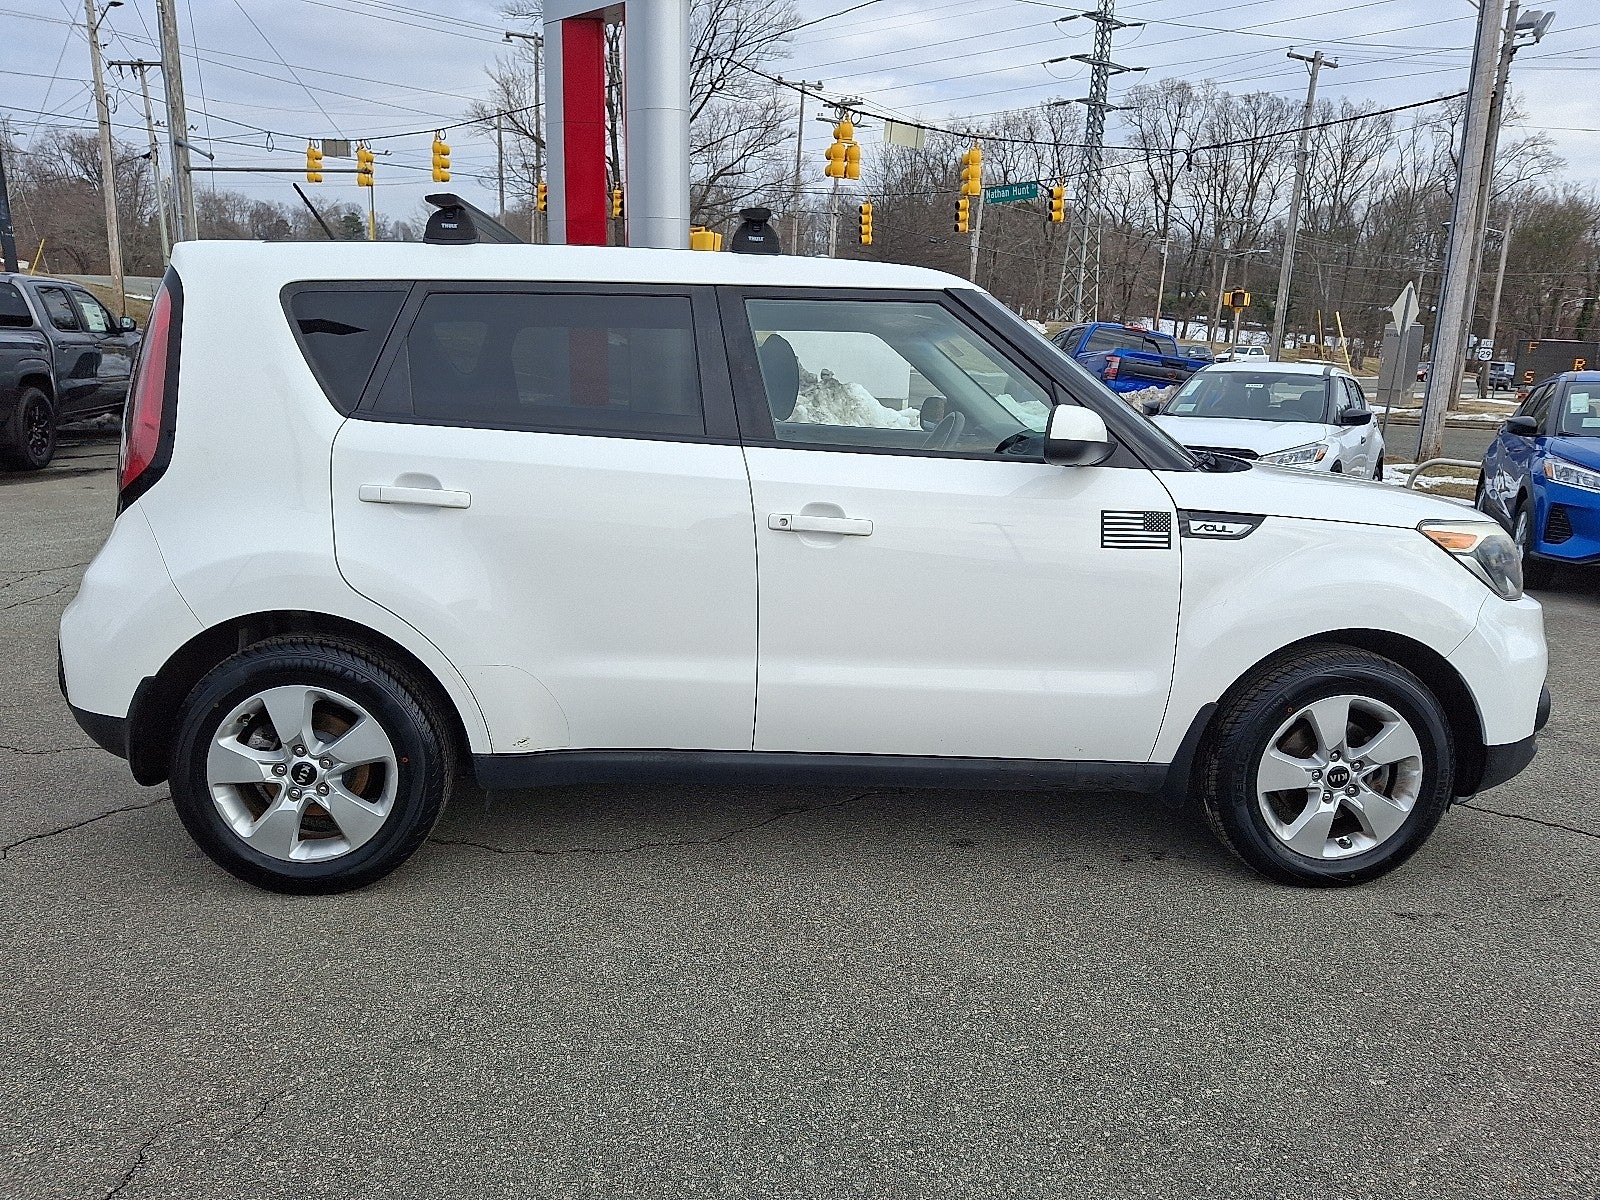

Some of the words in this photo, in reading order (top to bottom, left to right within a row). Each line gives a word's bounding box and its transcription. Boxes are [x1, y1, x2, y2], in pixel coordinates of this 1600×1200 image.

[986, 189, 1010, 199] Nathan
[1012, 185, 1030, 196] Hunt
[1480, 350, 1491, 359] 29
[1523, 370, 1535, 384] S
[296, 764, 311, 783] KIA
[1329, 772, 1348, 783] KIA
